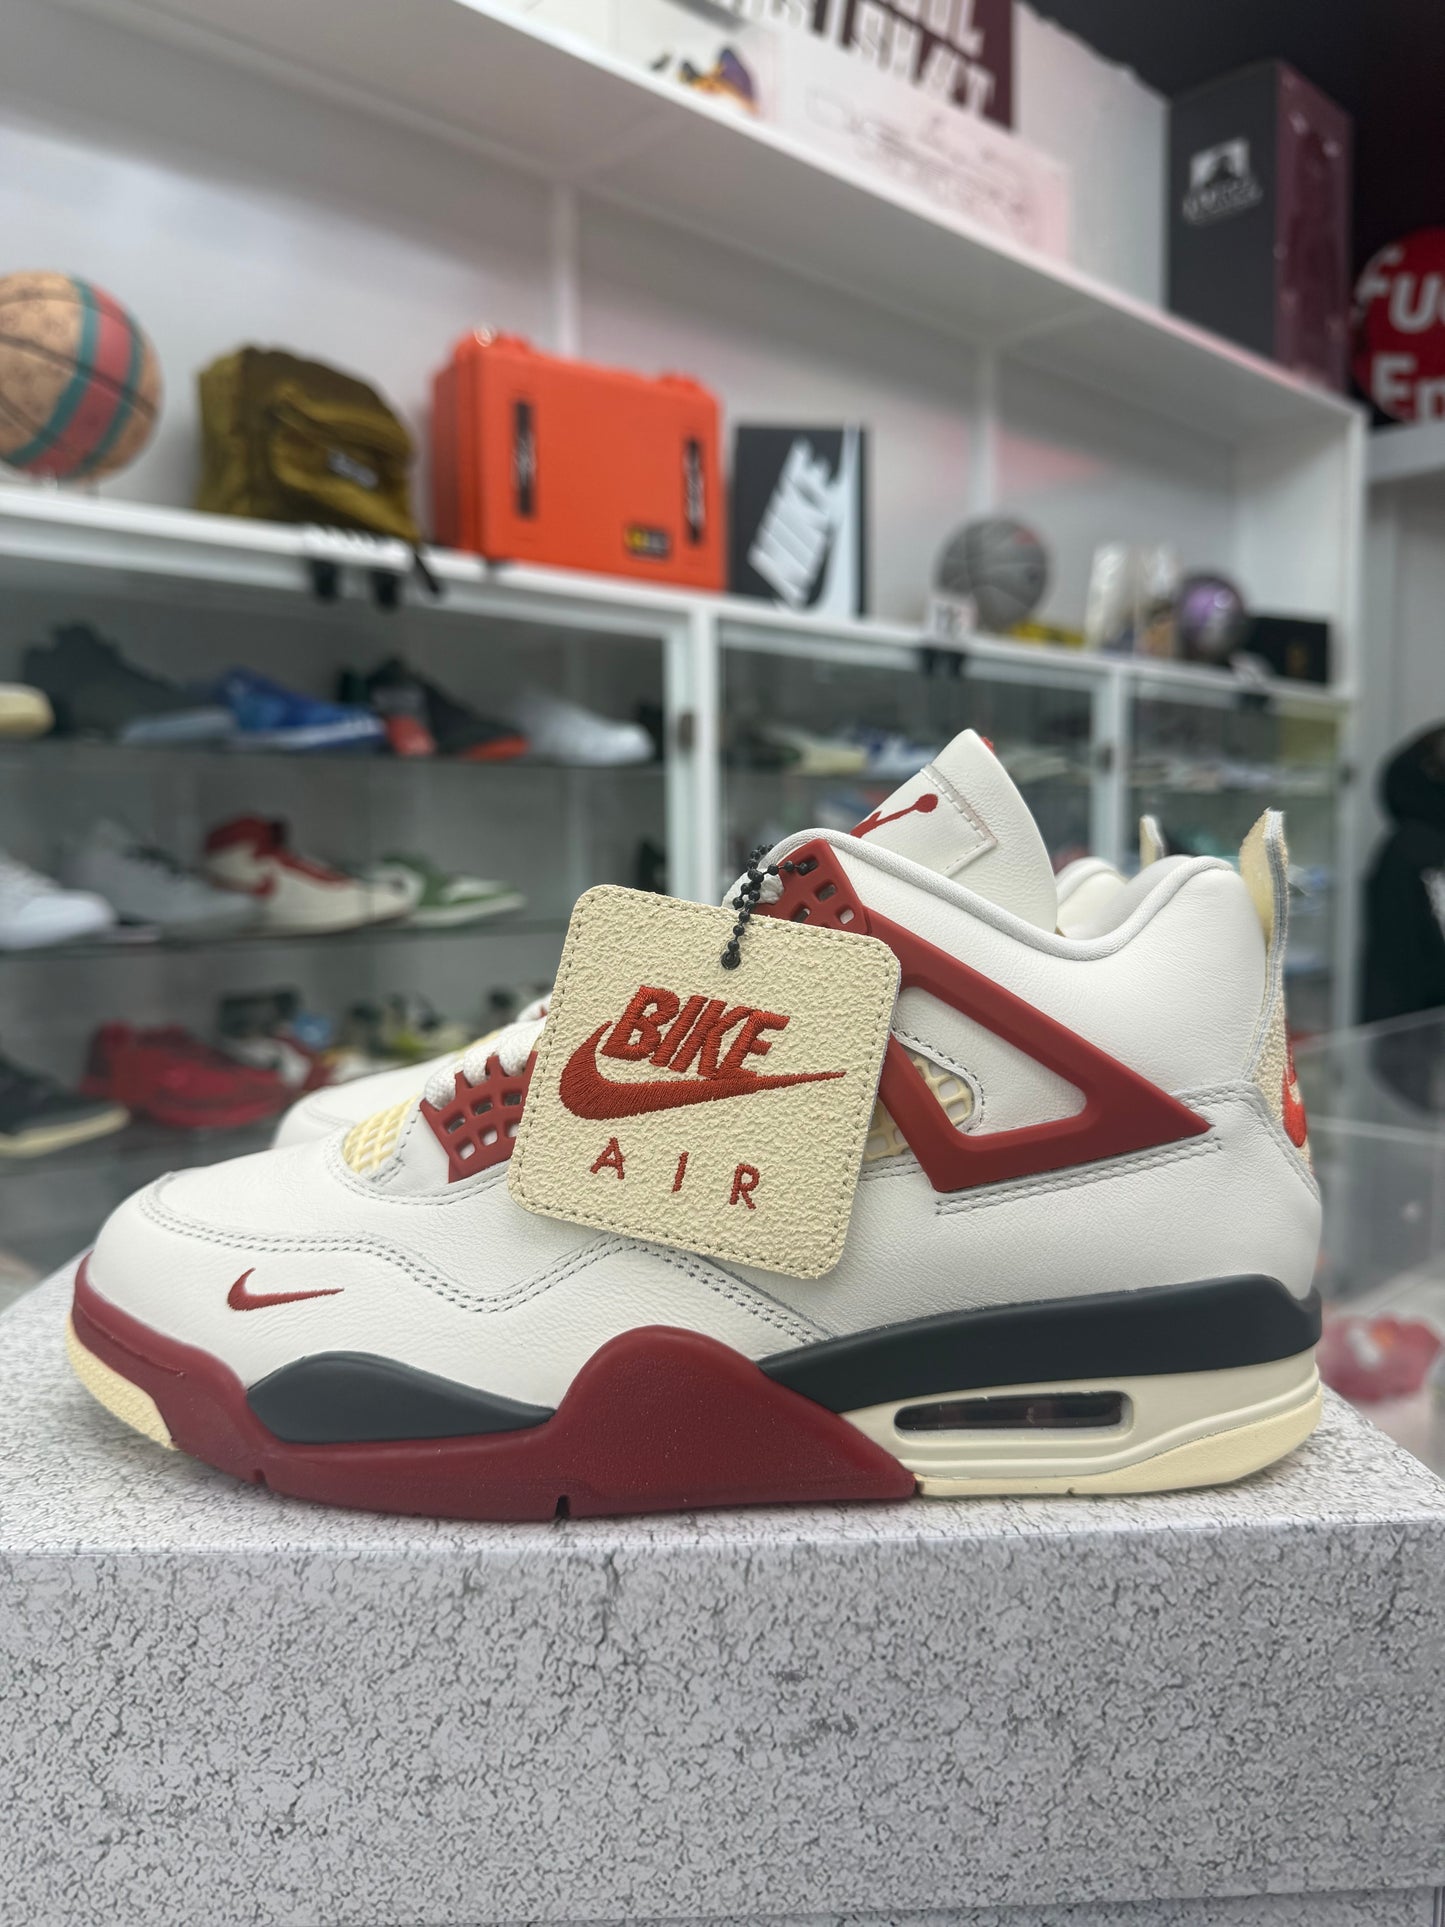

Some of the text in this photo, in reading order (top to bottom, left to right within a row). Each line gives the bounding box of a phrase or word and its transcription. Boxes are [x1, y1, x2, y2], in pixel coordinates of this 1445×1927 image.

[1355, 244, 1445, 334] Fu
[748, 434, 838, 608] NIKE
[601, 985, 790, 1080] BIKE
[589, 1136, 761, 1210] AIR
